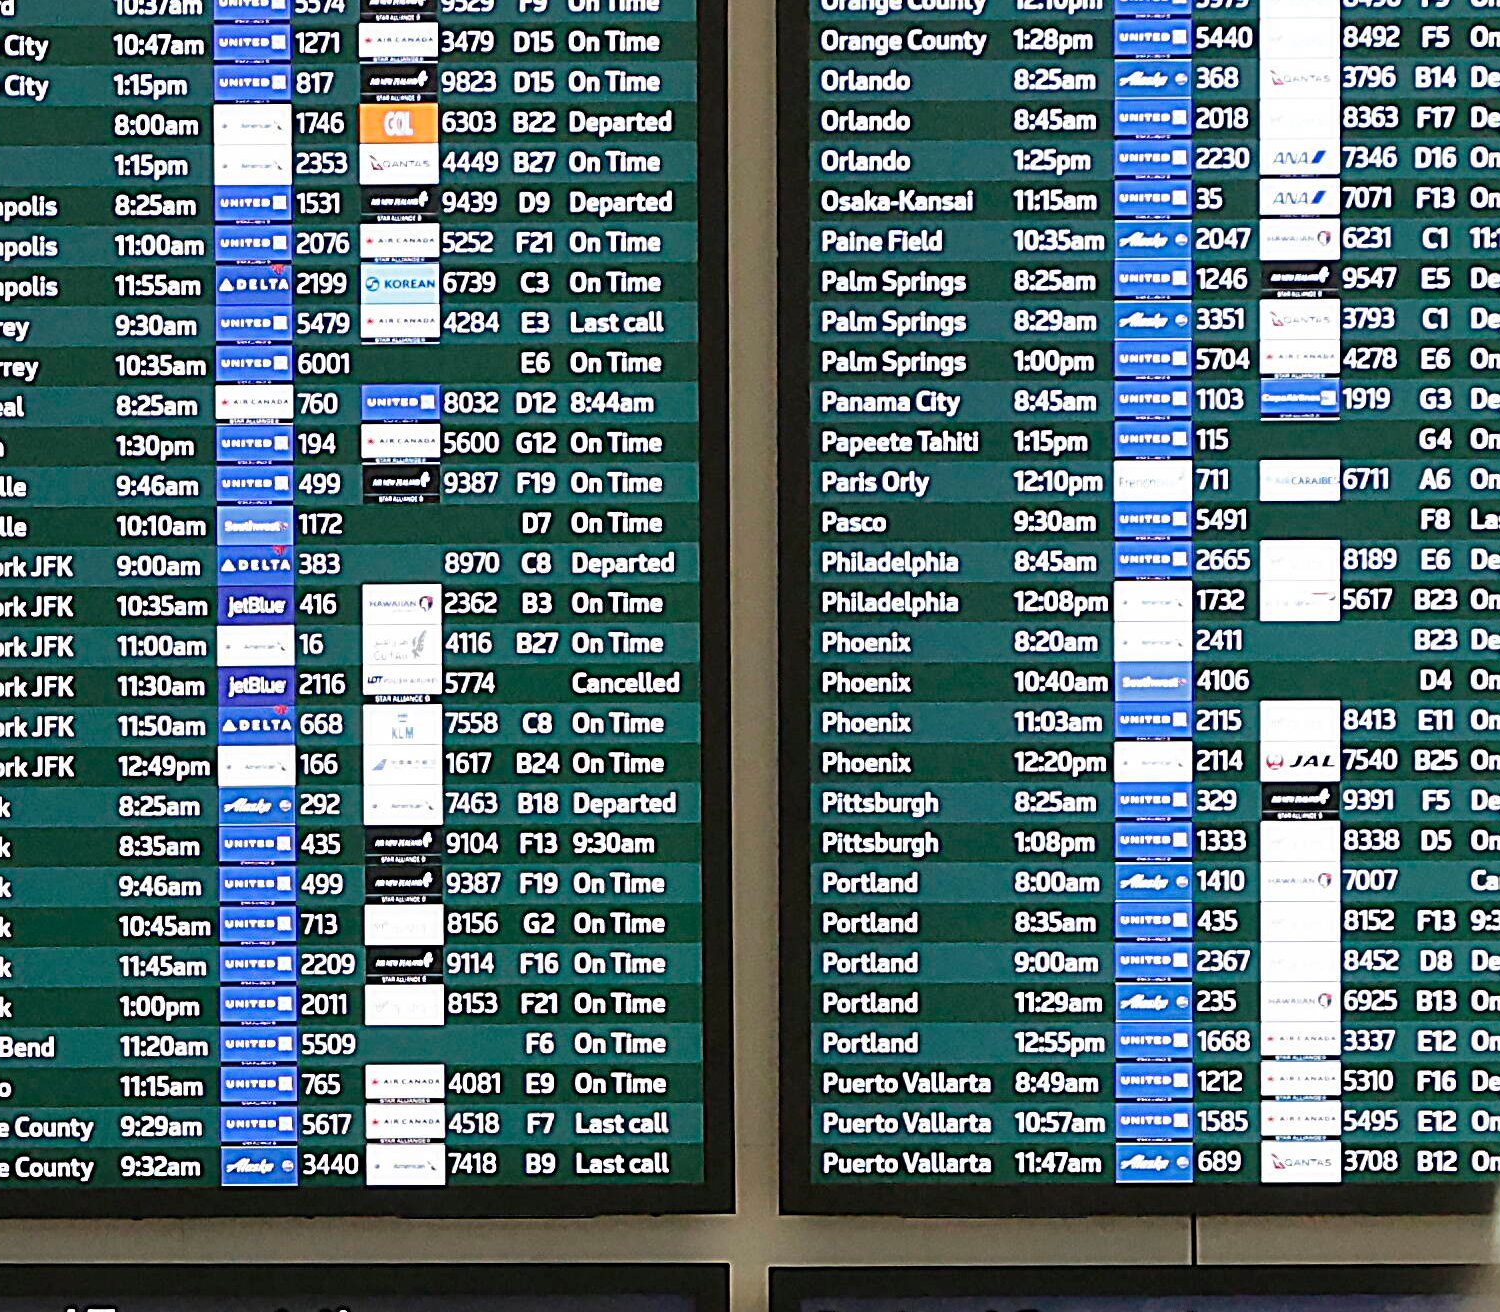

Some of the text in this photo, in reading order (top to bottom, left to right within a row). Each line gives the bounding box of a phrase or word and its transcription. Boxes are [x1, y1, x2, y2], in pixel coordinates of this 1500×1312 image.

[114, 273, 201, 296] 11:55am
[236, 278, 289, 291] DELTA
[296, 272, 348, 295] 2199
[384, 278, 436, 289] KOREAN
[442, 271, 497, 294] 6739
[520, 271, 550, 294] C3
[569, 271, 602, 293] On
[605, 270, 662, 293] Time
[821, 390, 911, 412] Panama
[915, 389, 961, 417] City
[1013, 389, 1097, 412] 8:45am
[1118, 393, 1171, 404] UNITED
[1196, 387, 1244, 410] 1103
[1342, 387, 1391, 410] 1919
[1419, 387, 1452, 410] G3
